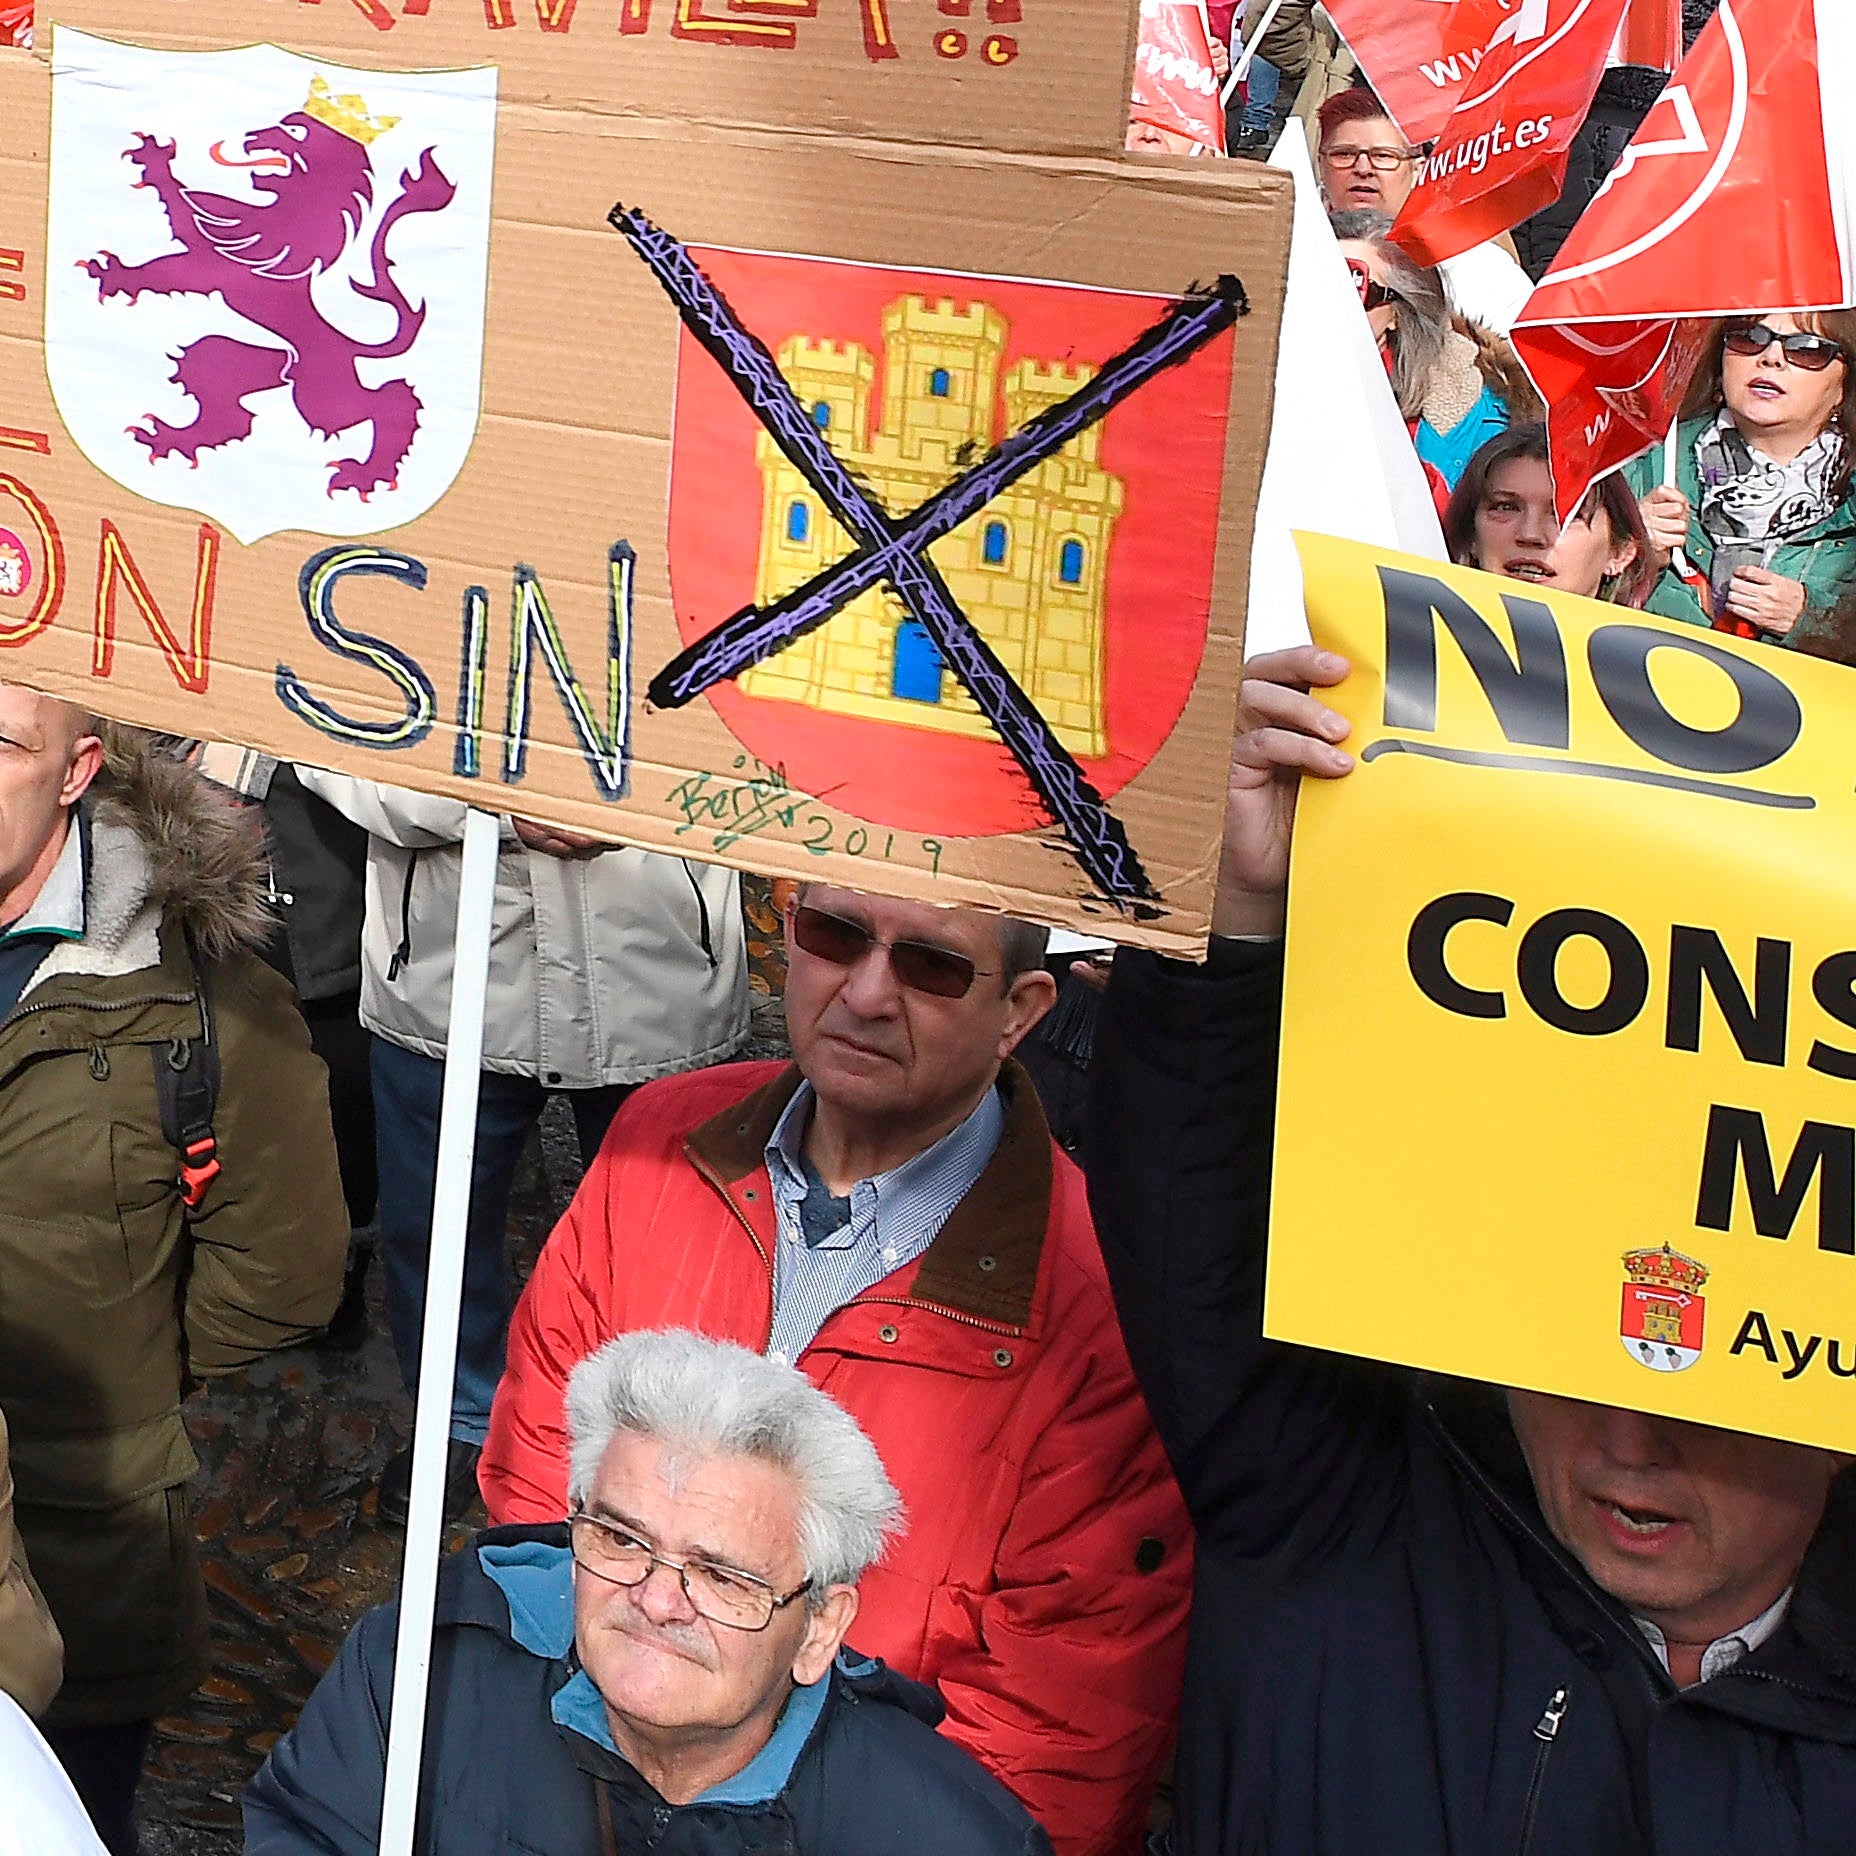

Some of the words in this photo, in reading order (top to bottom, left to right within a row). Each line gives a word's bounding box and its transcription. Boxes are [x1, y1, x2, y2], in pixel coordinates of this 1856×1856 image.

[271, 536, 641, 802] SIN
[1376, 564, 1802, 774] NO
[802, 815, 943, 878] 2019
